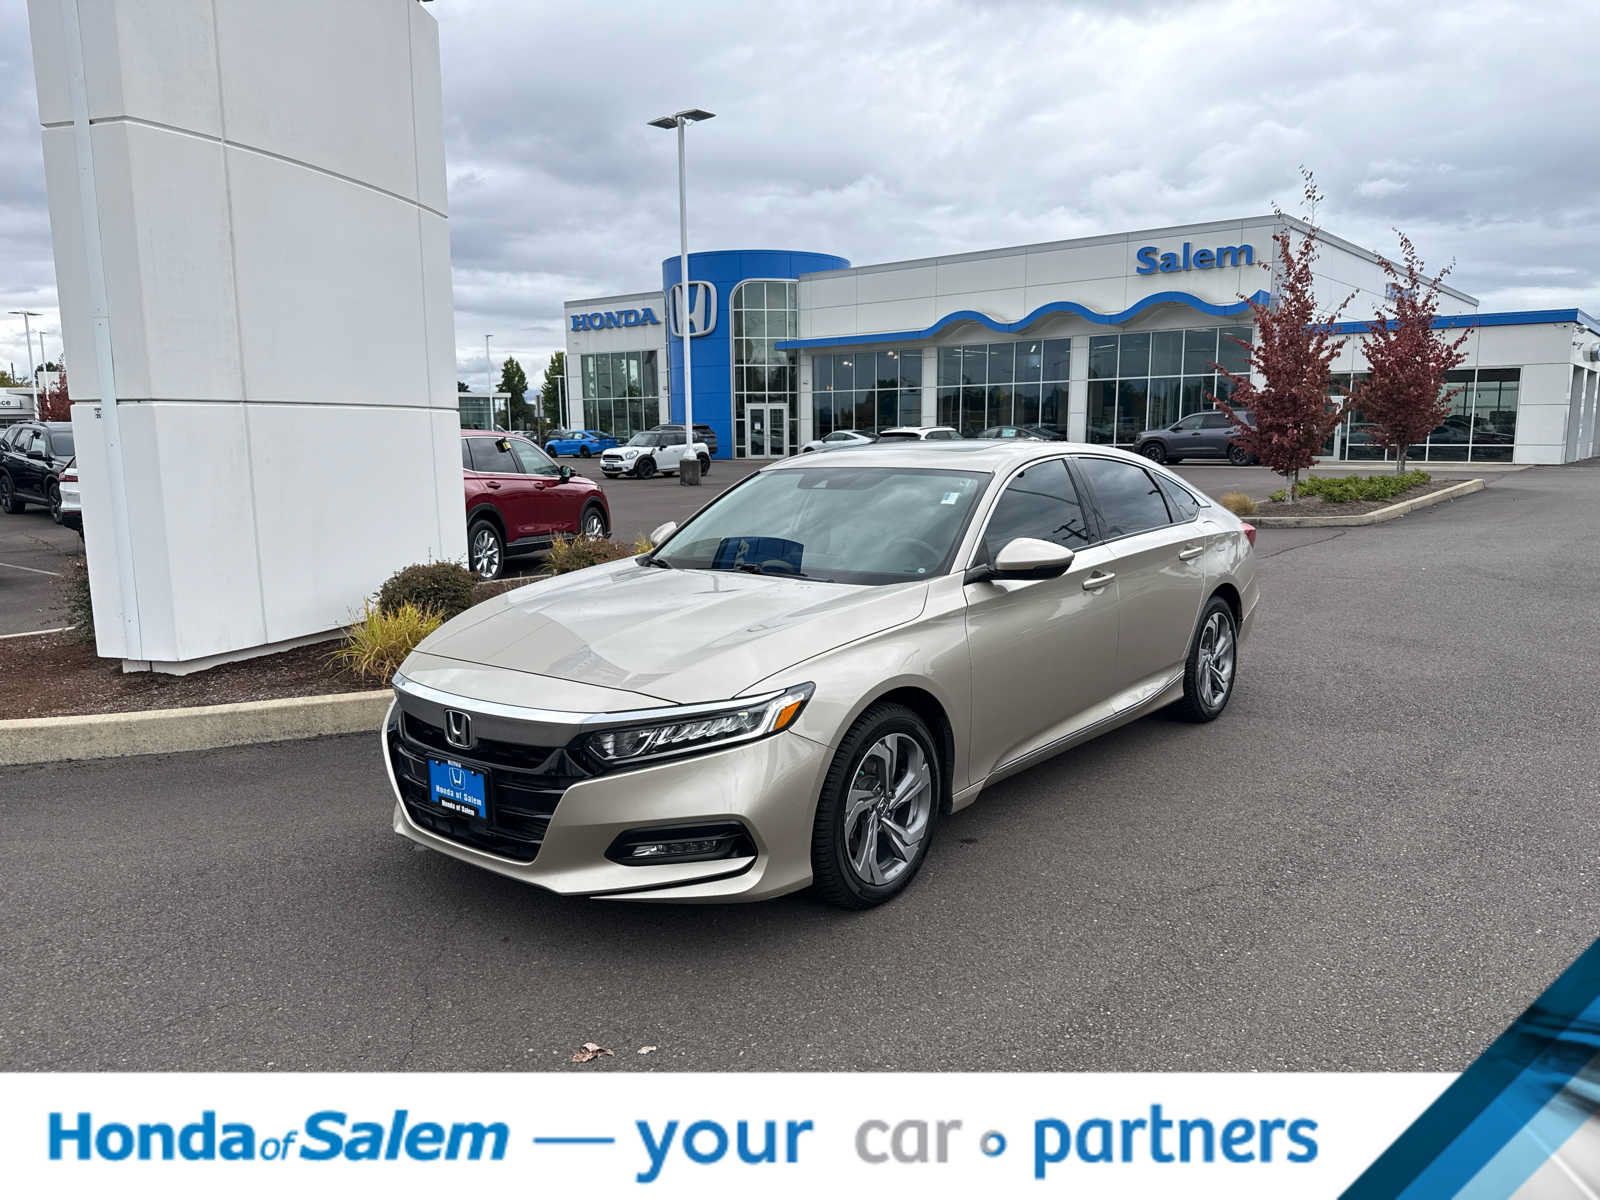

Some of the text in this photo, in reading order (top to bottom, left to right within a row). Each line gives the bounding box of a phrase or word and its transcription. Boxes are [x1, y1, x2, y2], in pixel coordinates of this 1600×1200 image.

[1136, 242, 1254, 275] Salem
[570, 307, 662, 332] HONDA
[463, 793, 482, 806] Salem
